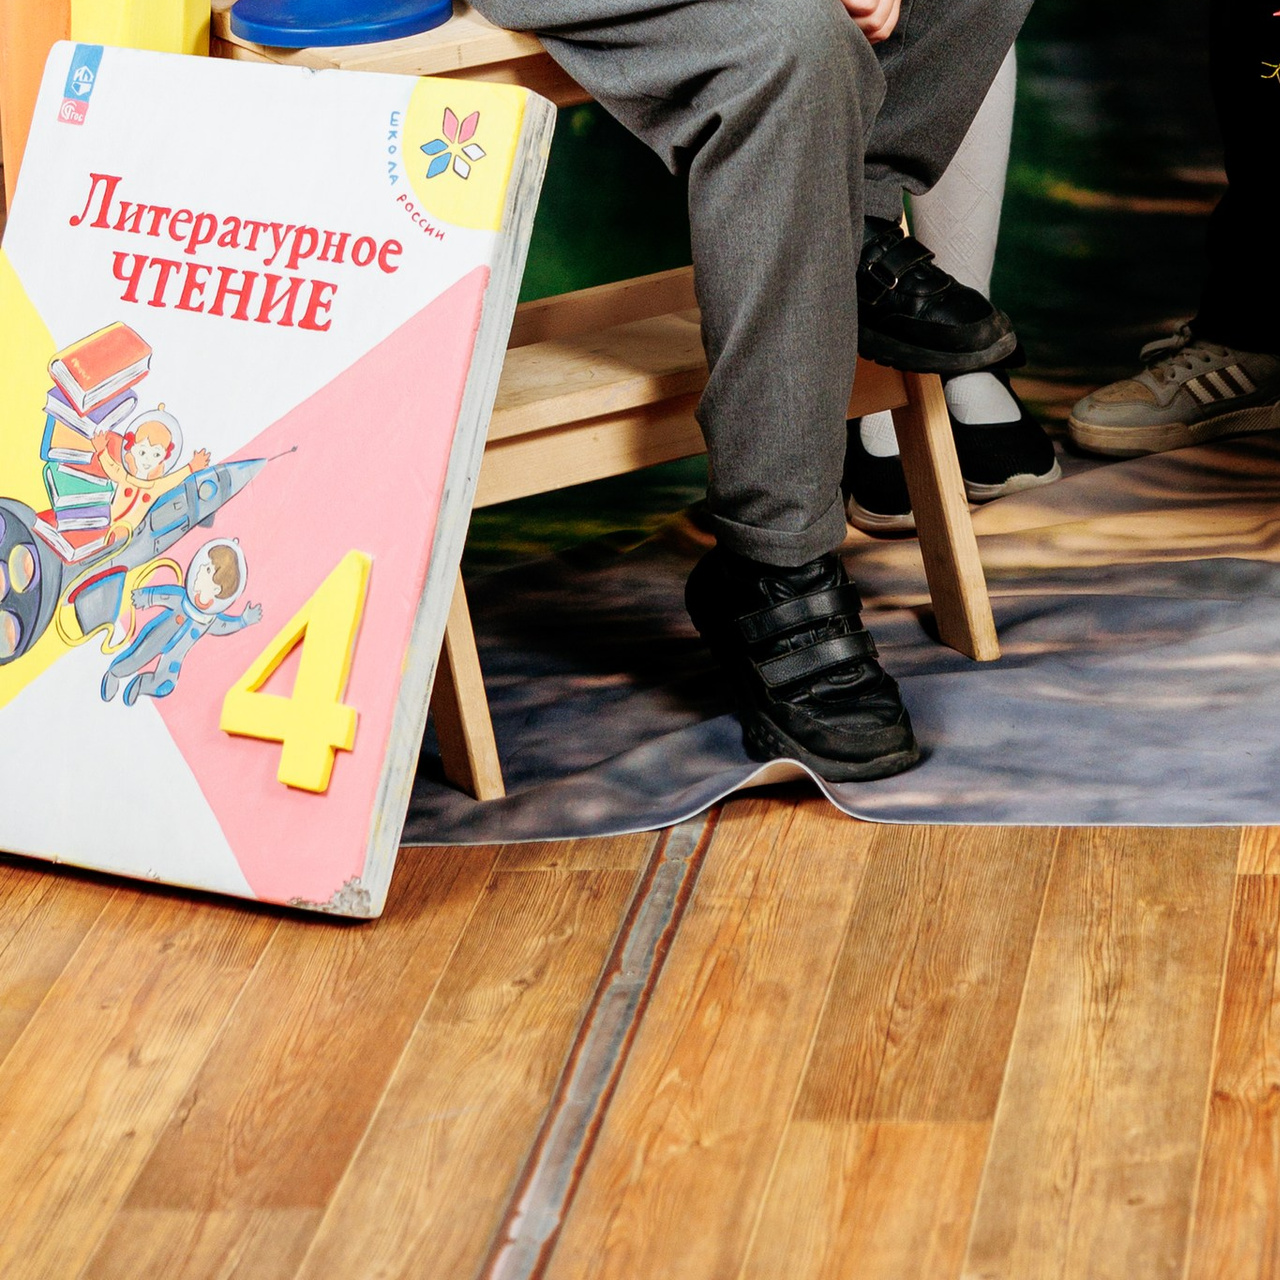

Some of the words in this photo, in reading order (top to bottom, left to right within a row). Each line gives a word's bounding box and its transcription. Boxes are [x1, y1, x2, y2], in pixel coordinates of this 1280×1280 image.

[70, 172, 402, 274] Литературное
[112, 251, 339, 332] ЧТЕНИЕ
[220, 549, 373, 793] 4
